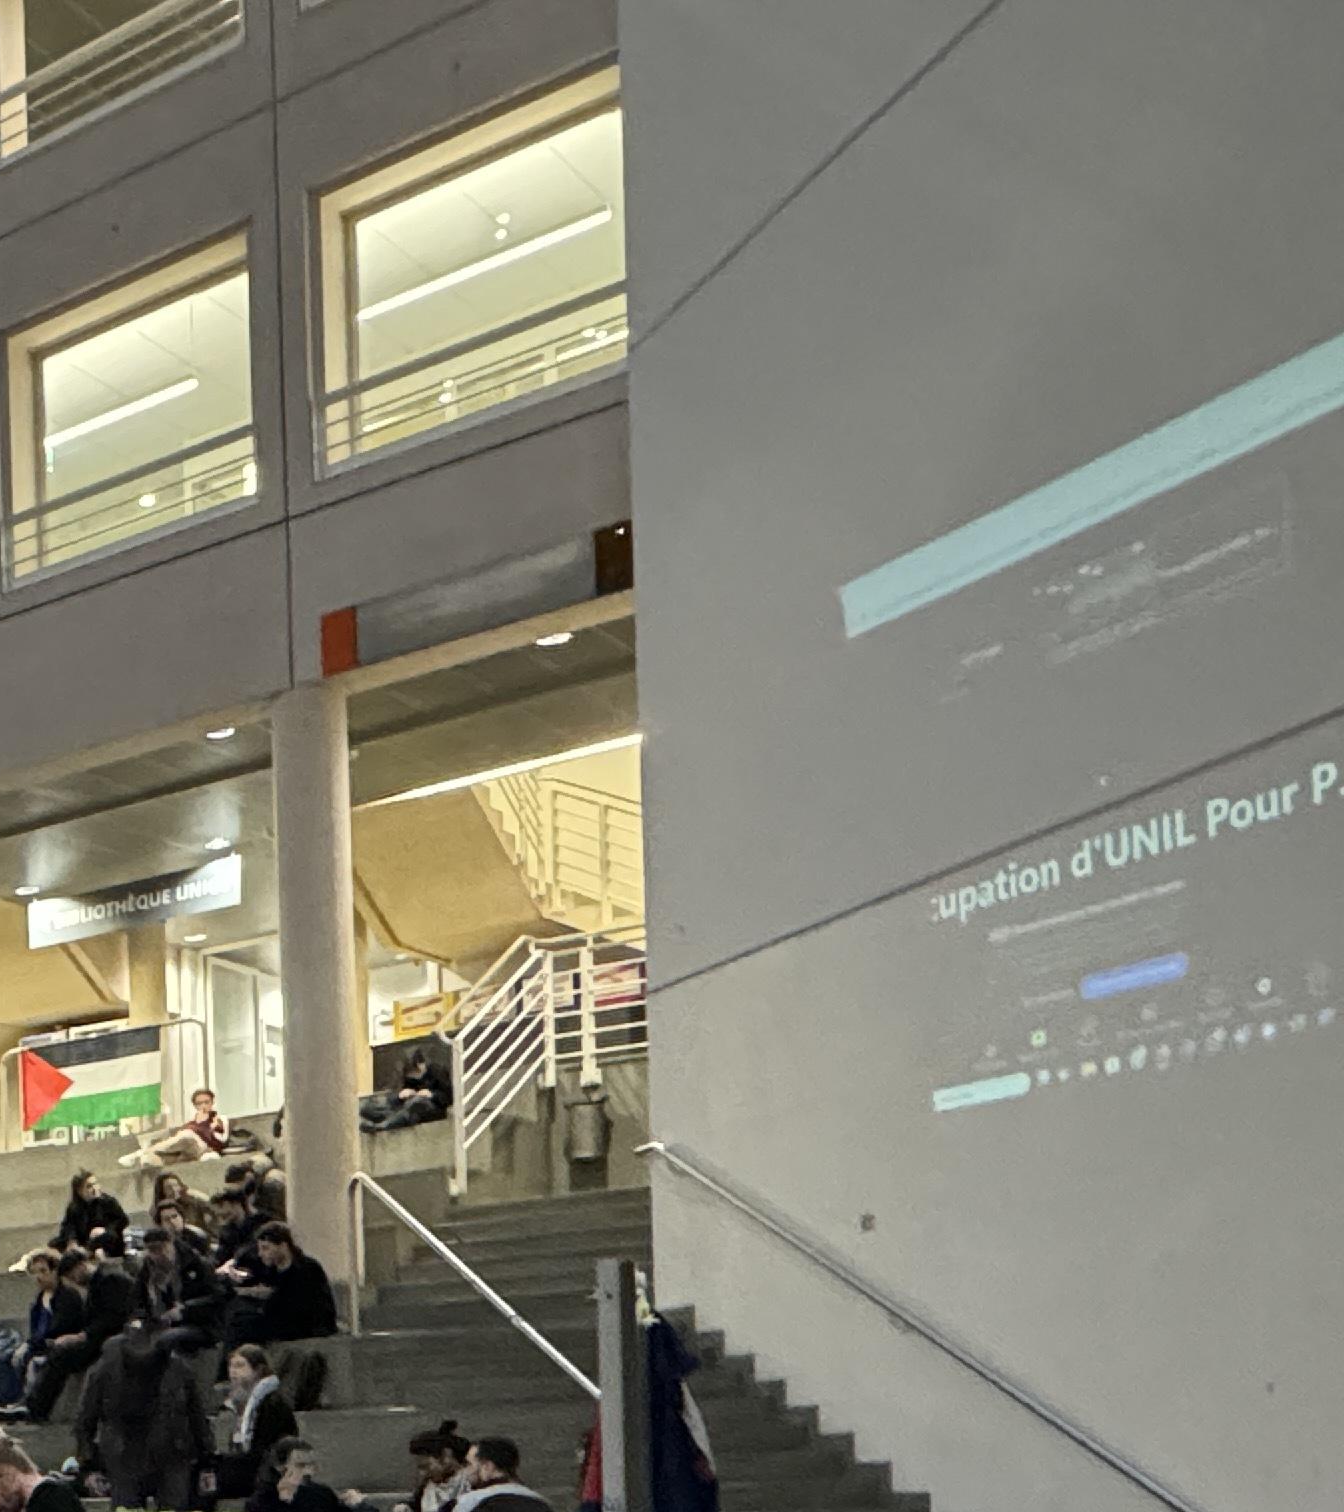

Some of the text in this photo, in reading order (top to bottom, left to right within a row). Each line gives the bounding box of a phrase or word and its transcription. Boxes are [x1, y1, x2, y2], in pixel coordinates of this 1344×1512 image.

[1070, 809, 1197, 878] d'UNIL
[1206, 781, 1300, 838] Pour
[1312, 762, 1344, 806] P
